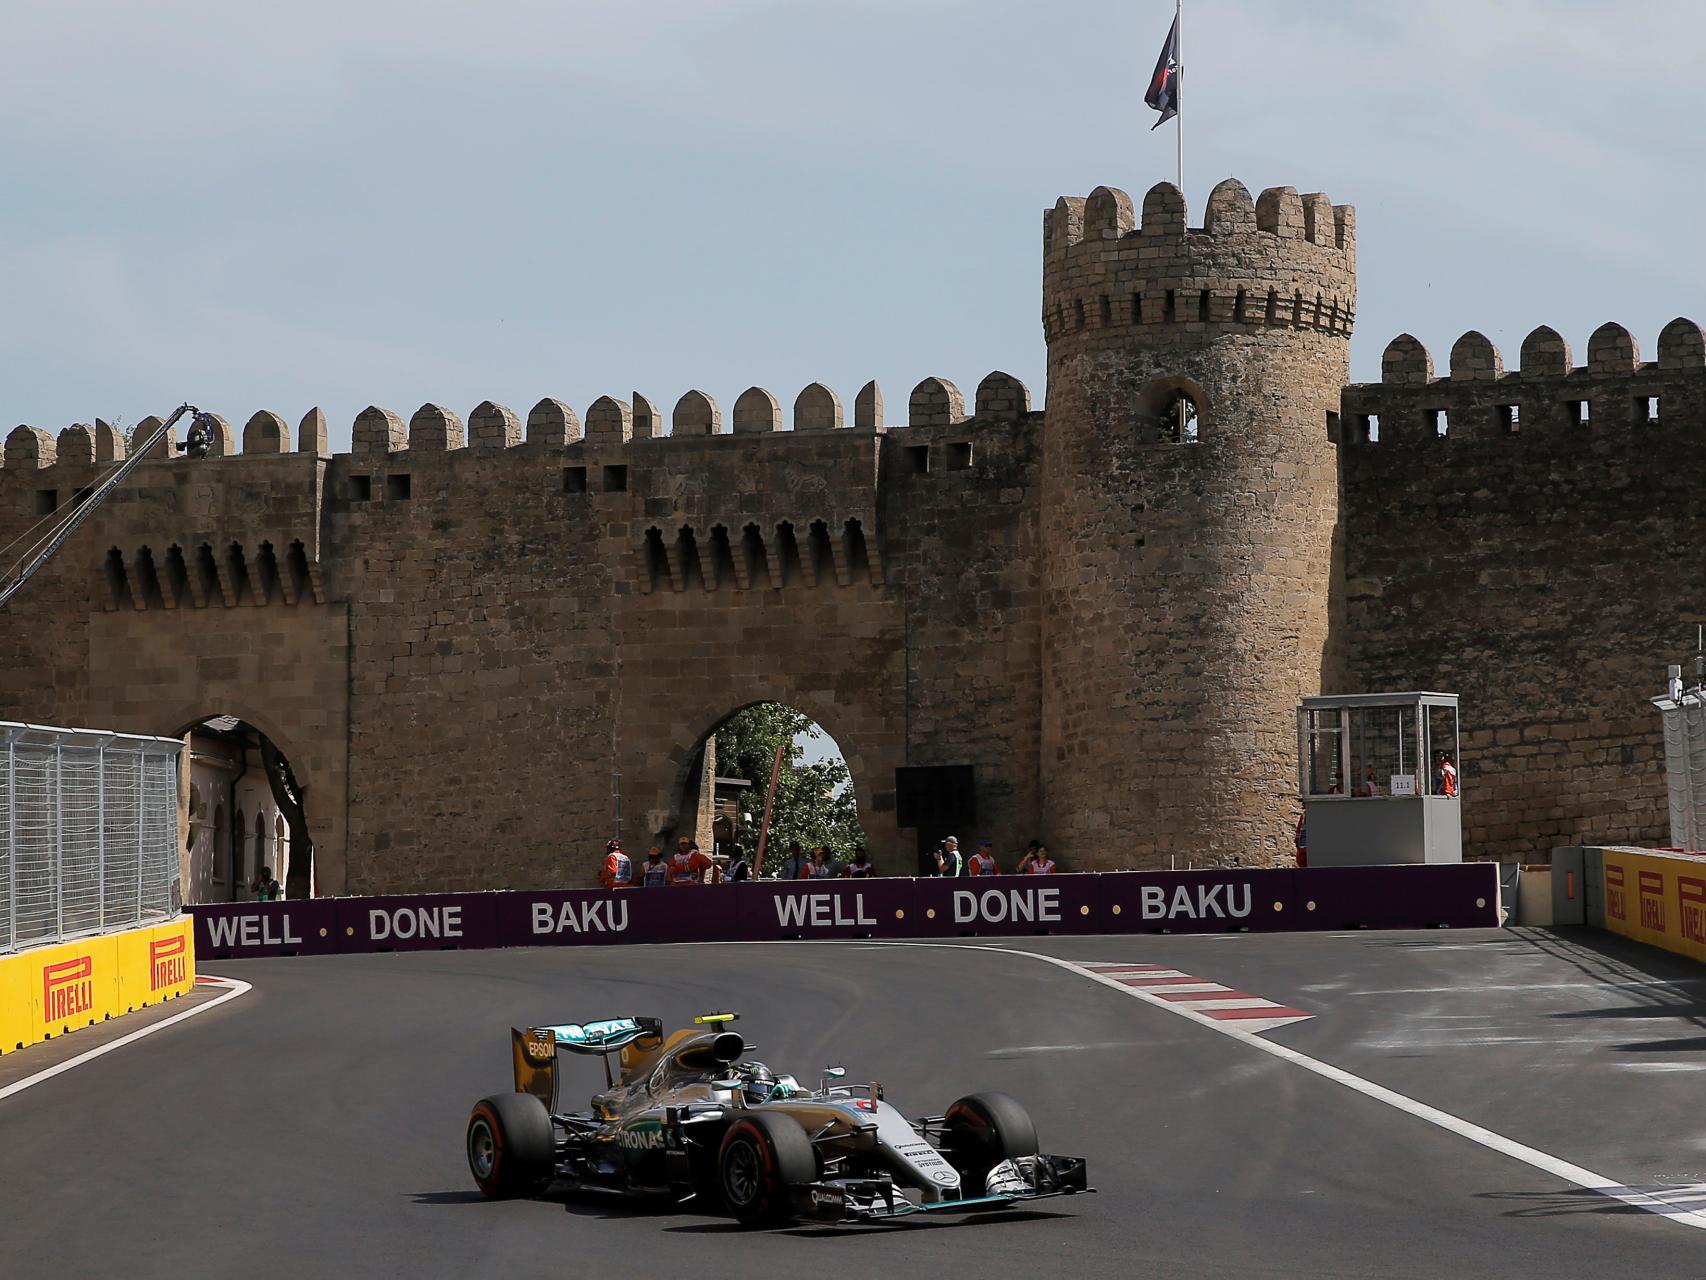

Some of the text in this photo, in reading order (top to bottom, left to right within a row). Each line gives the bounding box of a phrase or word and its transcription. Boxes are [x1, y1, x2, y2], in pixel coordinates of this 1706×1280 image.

[774, 883, 1252, 926] WELL DONE BAKU
[1606, 863, 1626, 920] PIRELLI
[1638, 870, 1666, 932] PIRELLI
[1677, 876, 1706, 945] PIREL
[207, 899, 629, 947] WELL DONE BAKU
[43, 955, 92, 1024] PIRELLI
[150, 935, 185, 992] PIRELLI
[528, 1041, 555, 1057] EPSON
